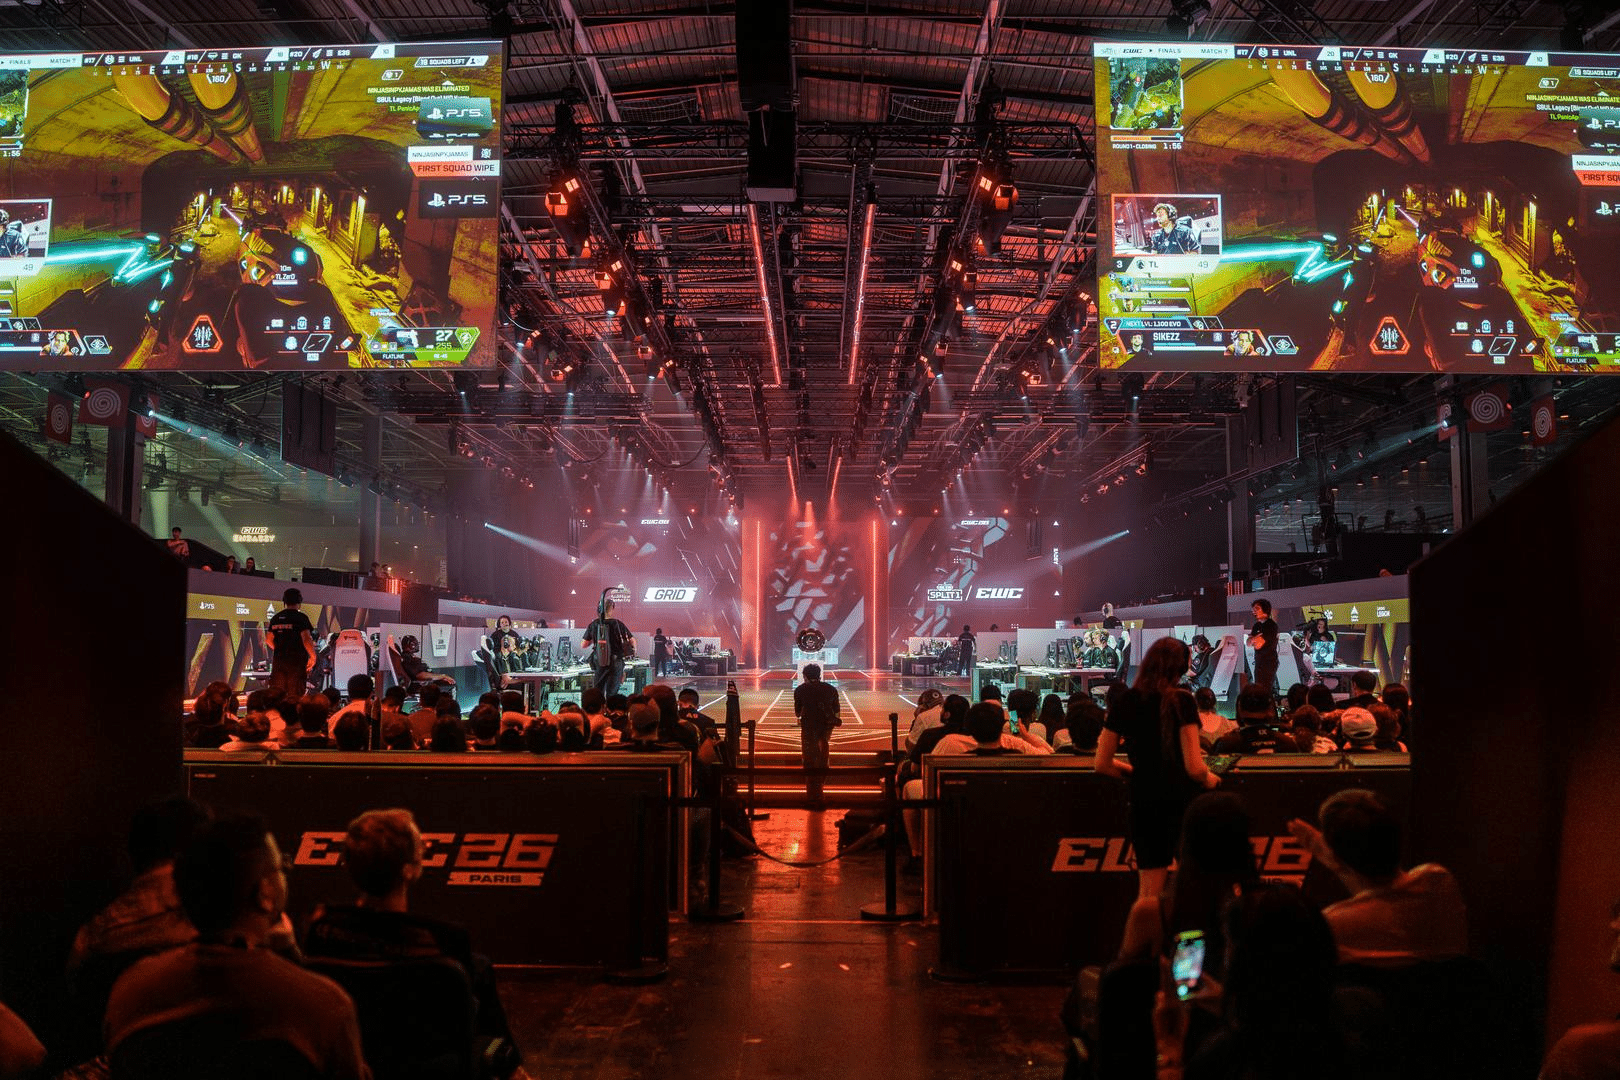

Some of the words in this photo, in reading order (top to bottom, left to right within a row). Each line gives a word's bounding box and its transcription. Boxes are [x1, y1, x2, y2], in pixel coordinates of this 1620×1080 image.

[212, 75, 225, 83] 180
[1370, 74, 1384, 82] 180
[446, 108, 483, 118] PS5
[417, 164, 440, 173] FIRST
[443, 164, 472, 172] SQUAD
[474, 164, 495, 172] WIPE
[448, 194, 487, 205] PS5
[23, 263, 34, 271] 49
[1116, 260, 1123, 269] 3
[1110, 321, 1118, 329] 2
[435, 329, 453, 342] 27
[1153, 332, 1180, 341] SIKEZZ
[232, 534, 275, 543] EMBASSY
[654, 589, 687, 601] GRID
[929, 591, 955, 599] SPLIT
[975, 587, 1024, 599] EWC
[294, 831, 559, 868] EC26
[469, 874, 521, 883] PARIS
